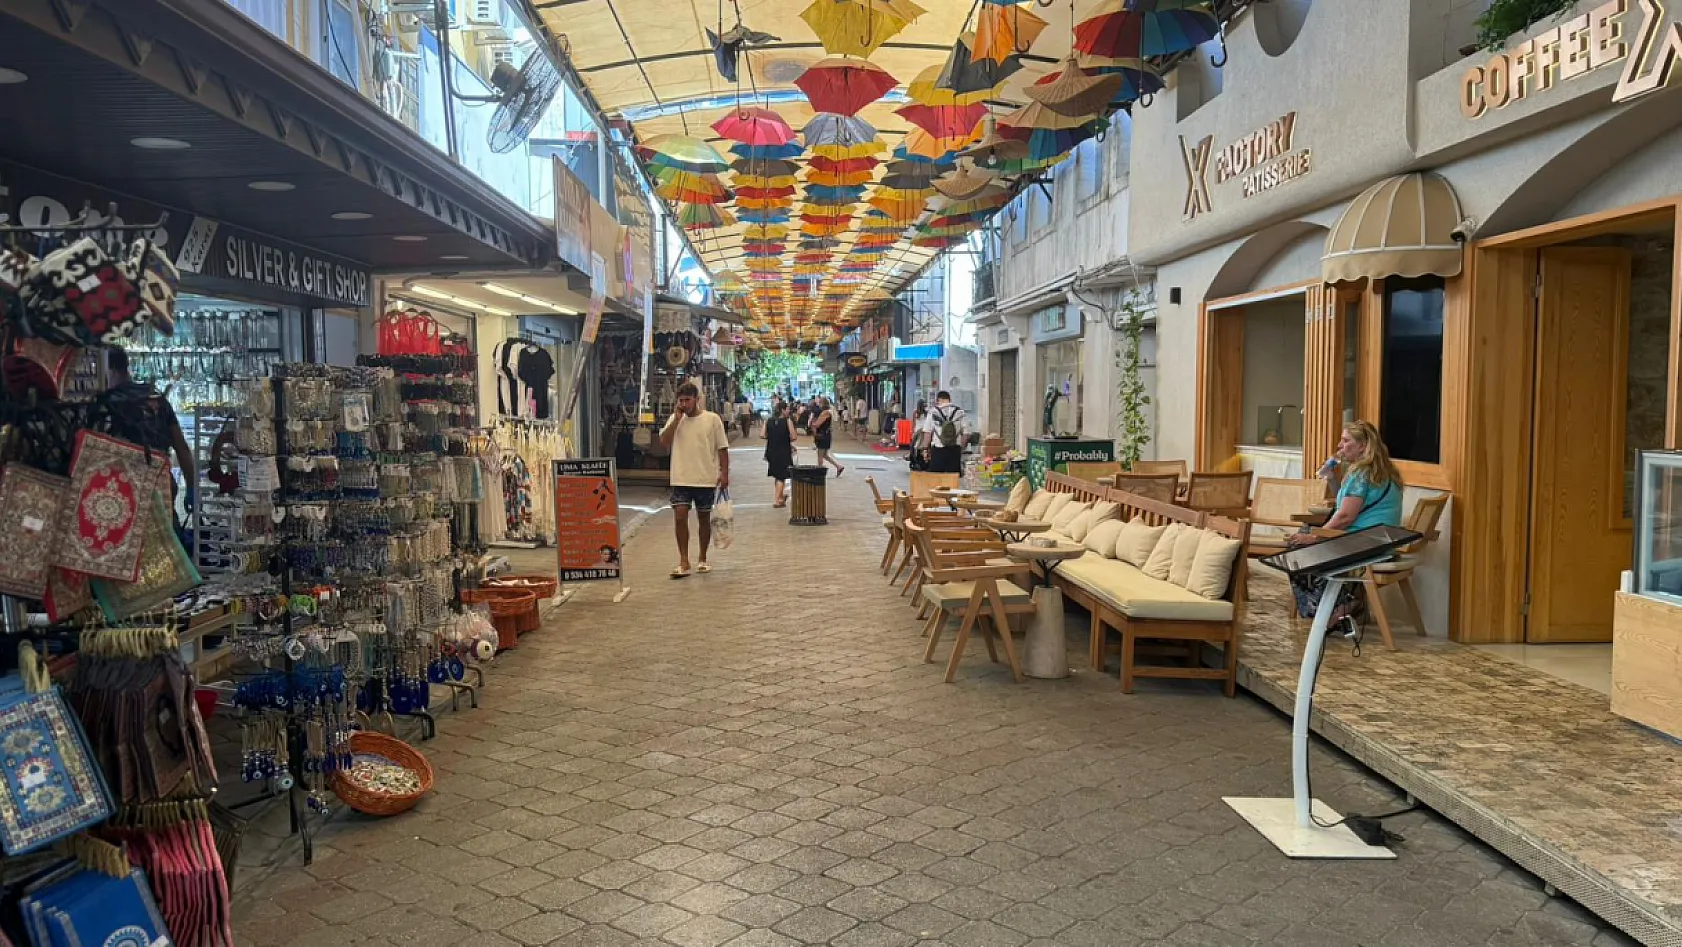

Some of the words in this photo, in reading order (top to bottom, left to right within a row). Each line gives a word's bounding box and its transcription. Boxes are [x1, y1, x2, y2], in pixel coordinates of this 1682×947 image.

[1460, 0, 1627, 119] COFFEE
[1216, 111, 1298, 185] FACTORY
[1243, 148, 1312, 199] PATISSERIE
[226, 235, 286, 287] SILVER
[289, 251, 300, 289] &
[303, 256, 332, 295] GIFT
[335, 264, 367, 302] SHOP
[1055, 450, 1108, 462] #Probably
